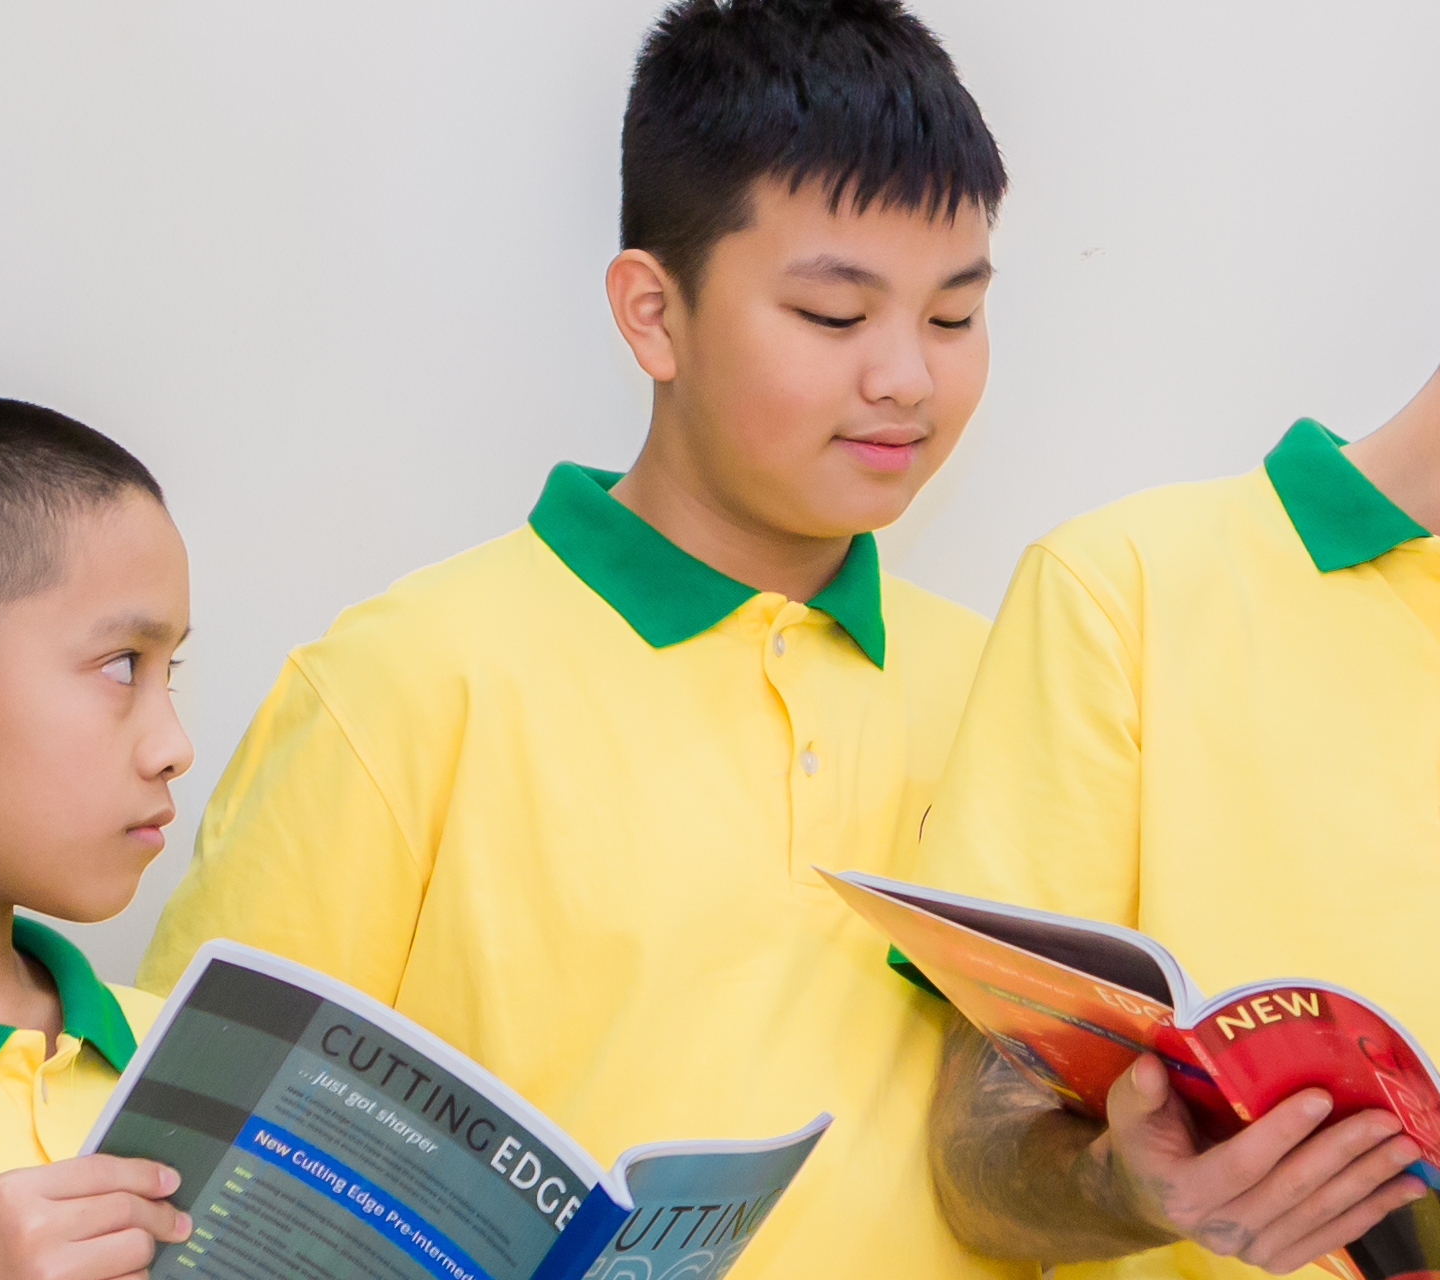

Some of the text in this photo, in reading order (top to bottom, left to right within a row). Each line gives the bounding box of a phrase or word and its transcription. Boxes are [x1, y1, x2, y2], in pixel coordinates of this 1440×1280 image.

[1216, 991, 1320, 1040] NEW
[321, 1024, 497, 1152] CUTTING
[490, 1136, 582, 1232] EDGE
[344, 1089, 378, 1116] got
[375, 1106, 439, 1155] sharper
[254, 1129, 292, 1158] New
[292, 1150, 345, 1194] Cutting
[346, 1184, 383, 1217] Edge
[615, 1188, 783, 1252] UTTING
